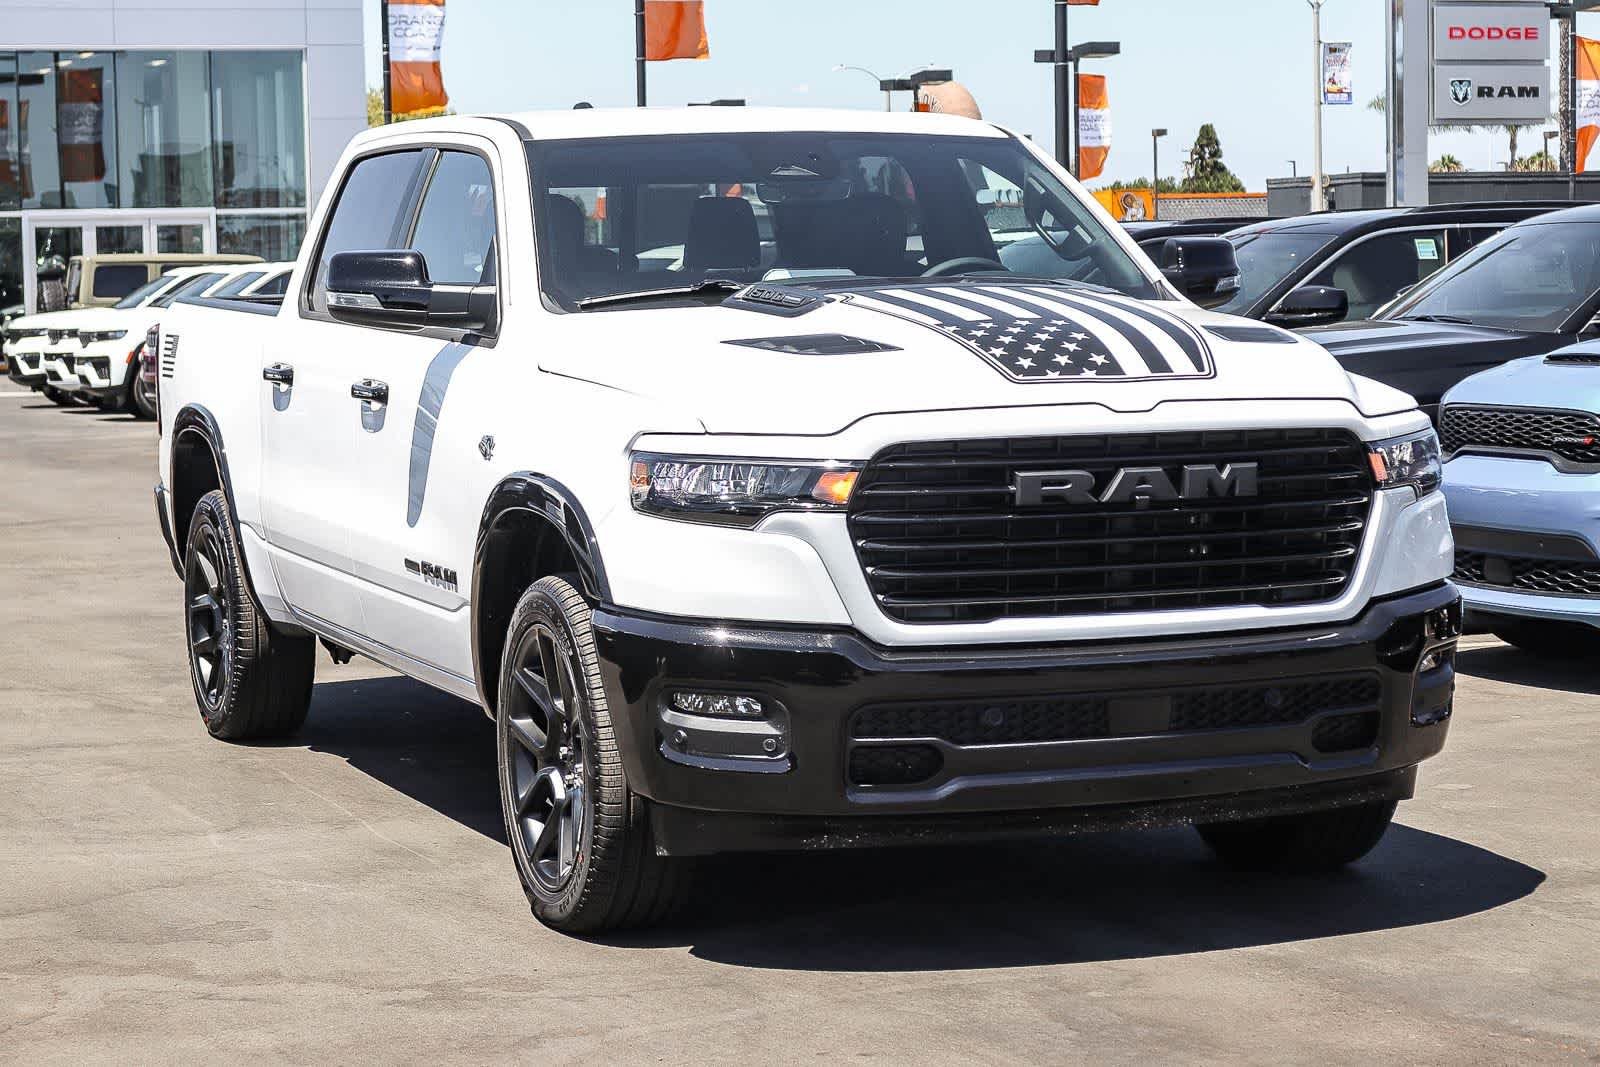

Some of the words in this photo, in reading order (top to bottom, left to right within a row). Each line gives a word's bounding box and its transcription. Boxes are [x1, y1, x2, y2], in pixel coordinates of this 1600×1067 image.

[1448, 26, 1539, 40] DODGE
[1477, 86, 1540, 98] RAM
[1015, 462, 1259, 507] RAM
[420, 560, 458, 586] RAM
